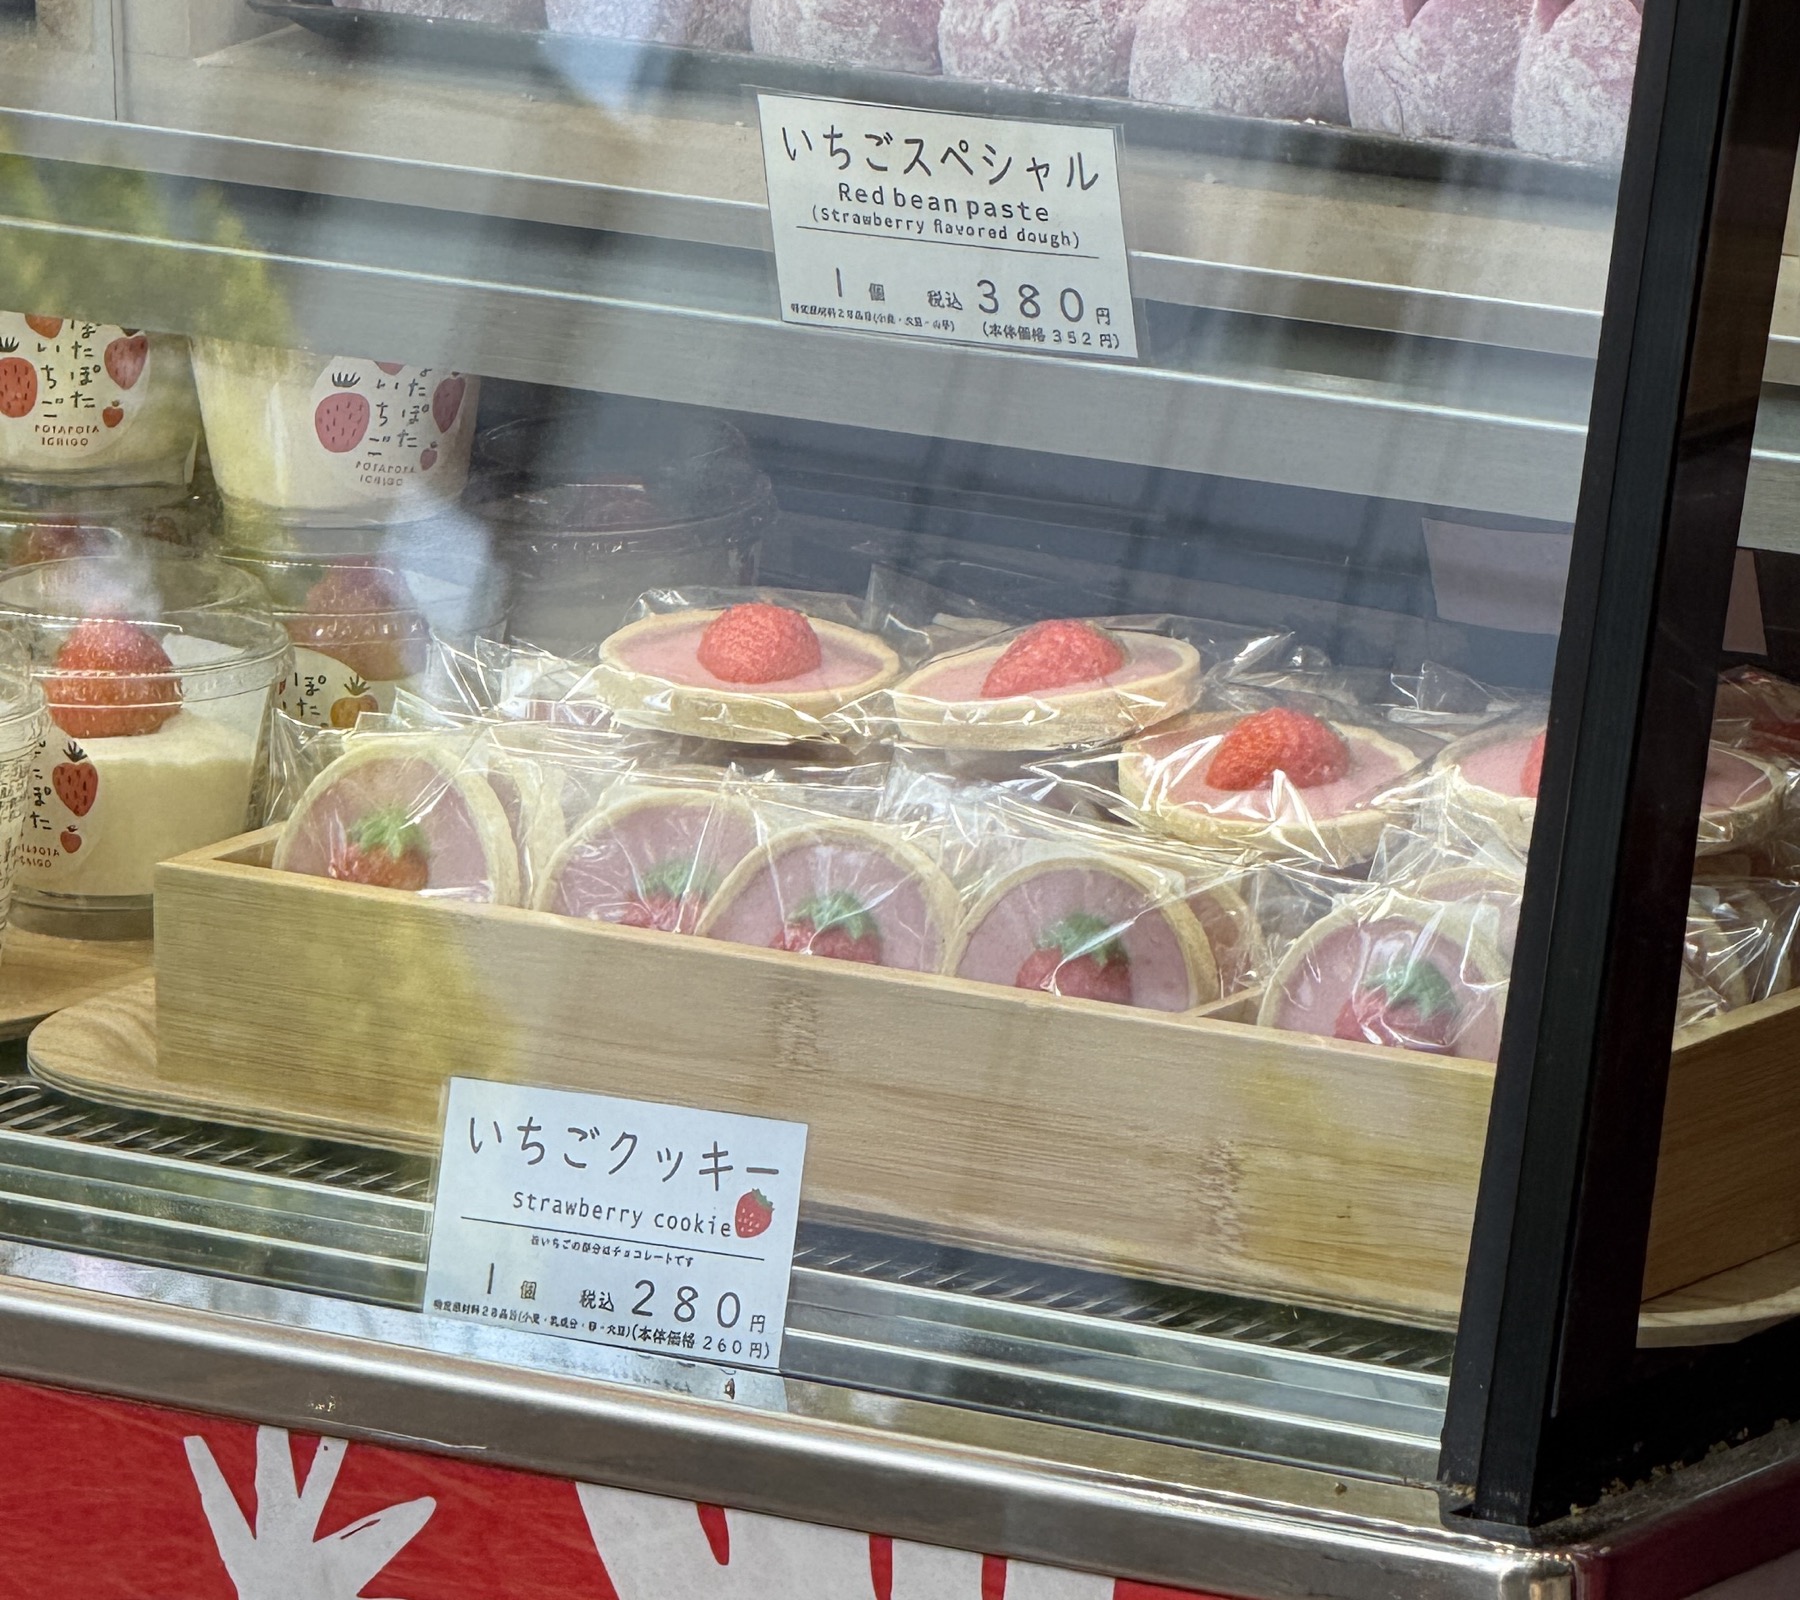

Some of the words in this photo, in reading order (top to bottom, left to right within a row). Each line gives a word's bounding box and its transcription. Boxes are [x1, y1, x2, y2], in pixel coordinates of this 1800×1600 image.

[781, 124, 1099, 192] いちごスペシャル
[838, 182, 885, 206] Red
[893, 187, 958, 215] bean
[966, 199, 1050, 223] paste
[933, 219, 1008, 242] flavored
[1016, 227, 1080, 250] dough)
[975, 279, 1112, 326] 380円
[468, 1115, 780, 1191] いちごクッキー
[653, 1208, 732, 1238] cookie
[579, 1287, 615, 1313] 税込
[631, 1279, 767, 1333] 280円
